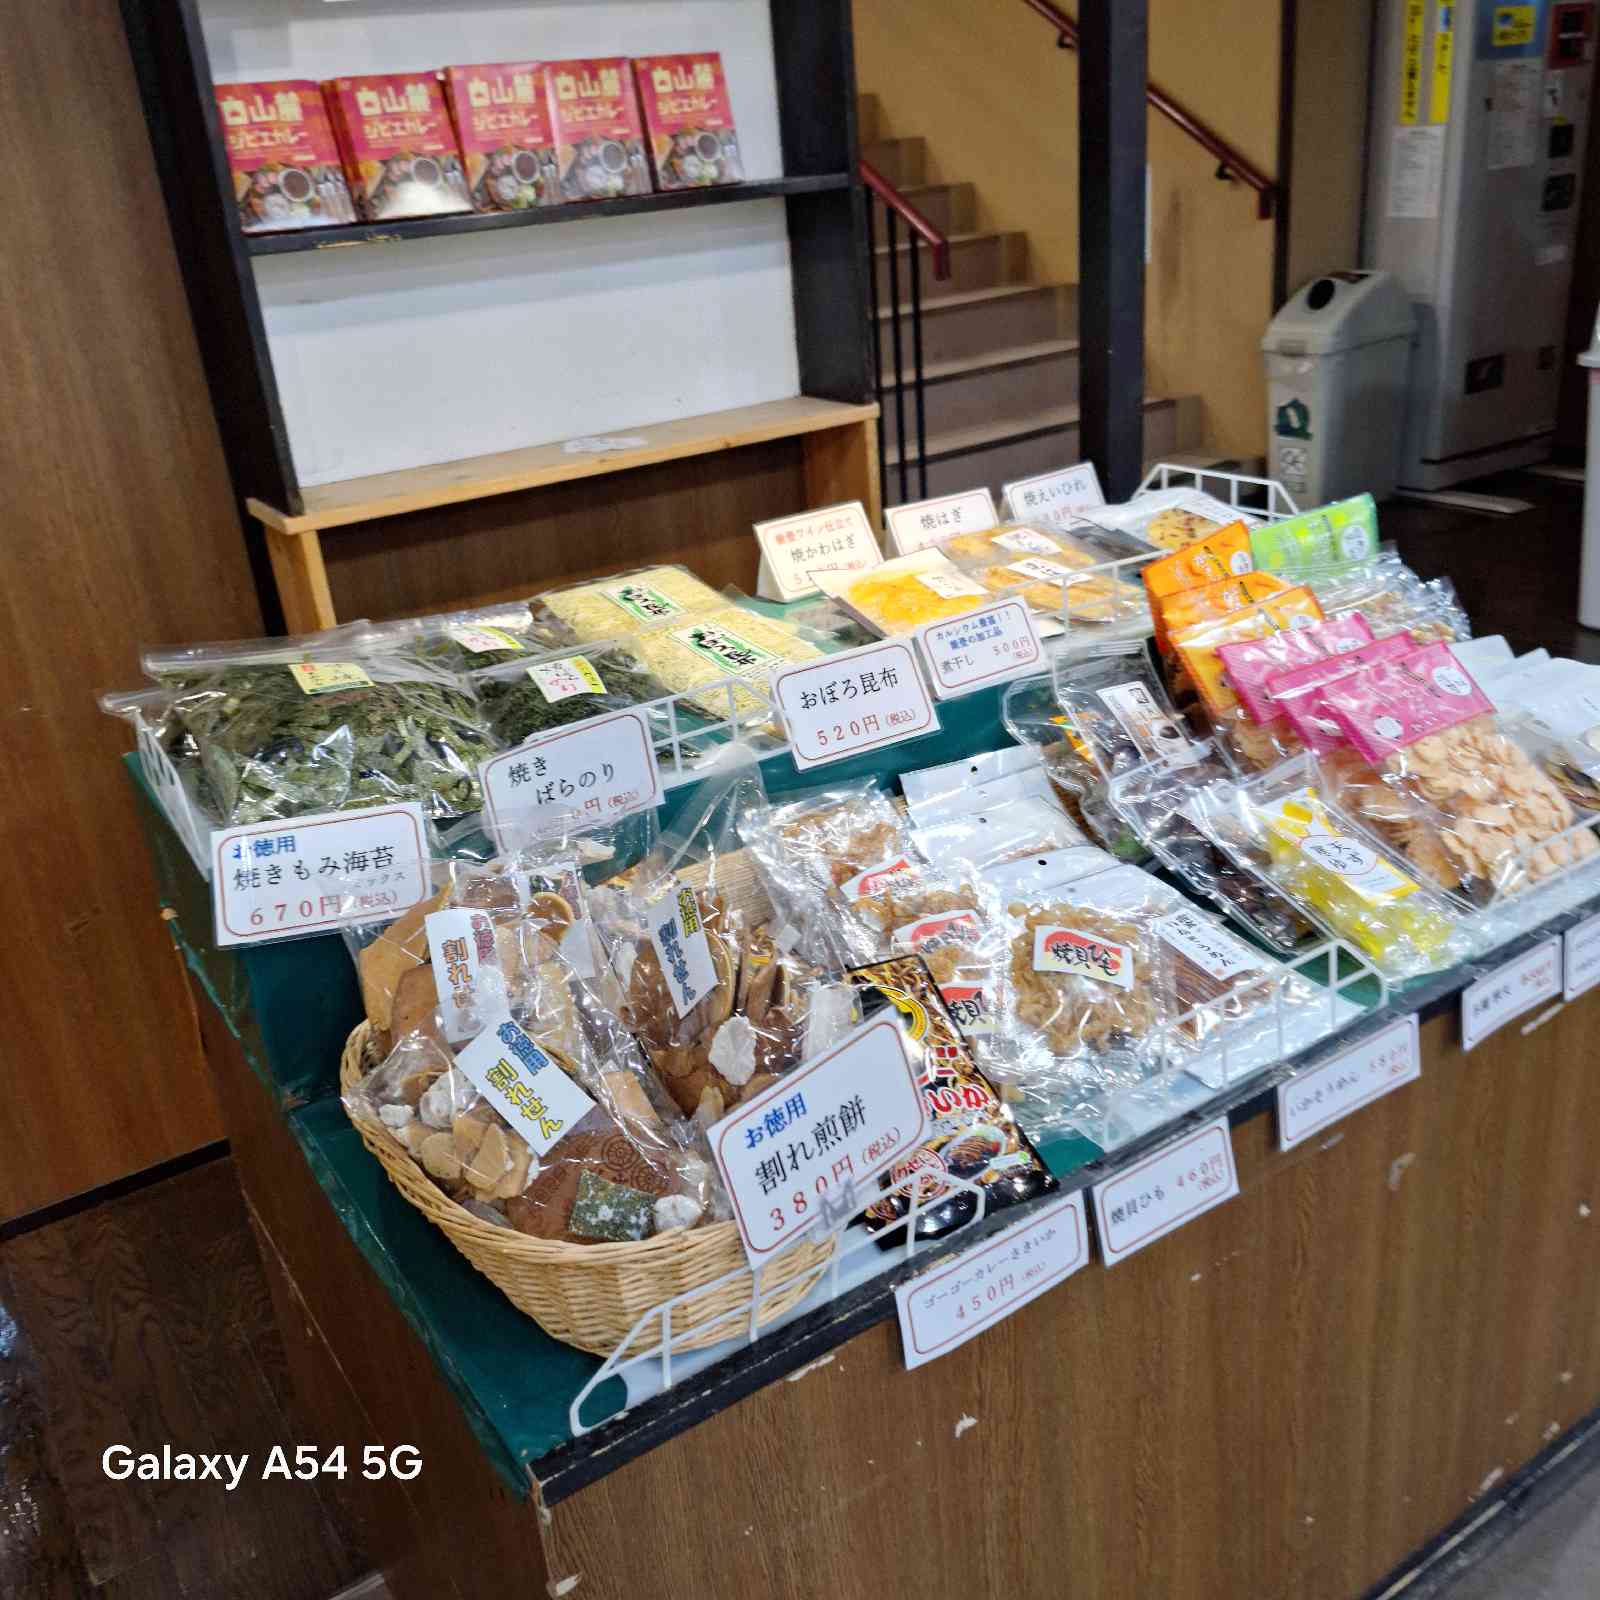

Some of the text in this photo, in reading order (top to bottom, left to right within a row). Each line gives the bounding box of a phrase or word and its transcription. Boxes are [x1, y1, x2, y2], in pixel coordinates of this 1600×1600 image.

[799, 667, 899, 709] おぼろ昆布
[816, 713, 881, 746] 520円
[508, 756, 547, 788] 焼き
[536, 763, 615, 805] ばらのり
[234, 845, 394, 891] 焼きもみ海苔
[250, 894, 343, 926] 670円
[485, 1058, 564, 1140] 割れせん
[745, 1093, 808, 1149] お徳用
[755, 1094, 867, 1195] 割れ煎餅
[770, 1154, 855, 1231] 380円
